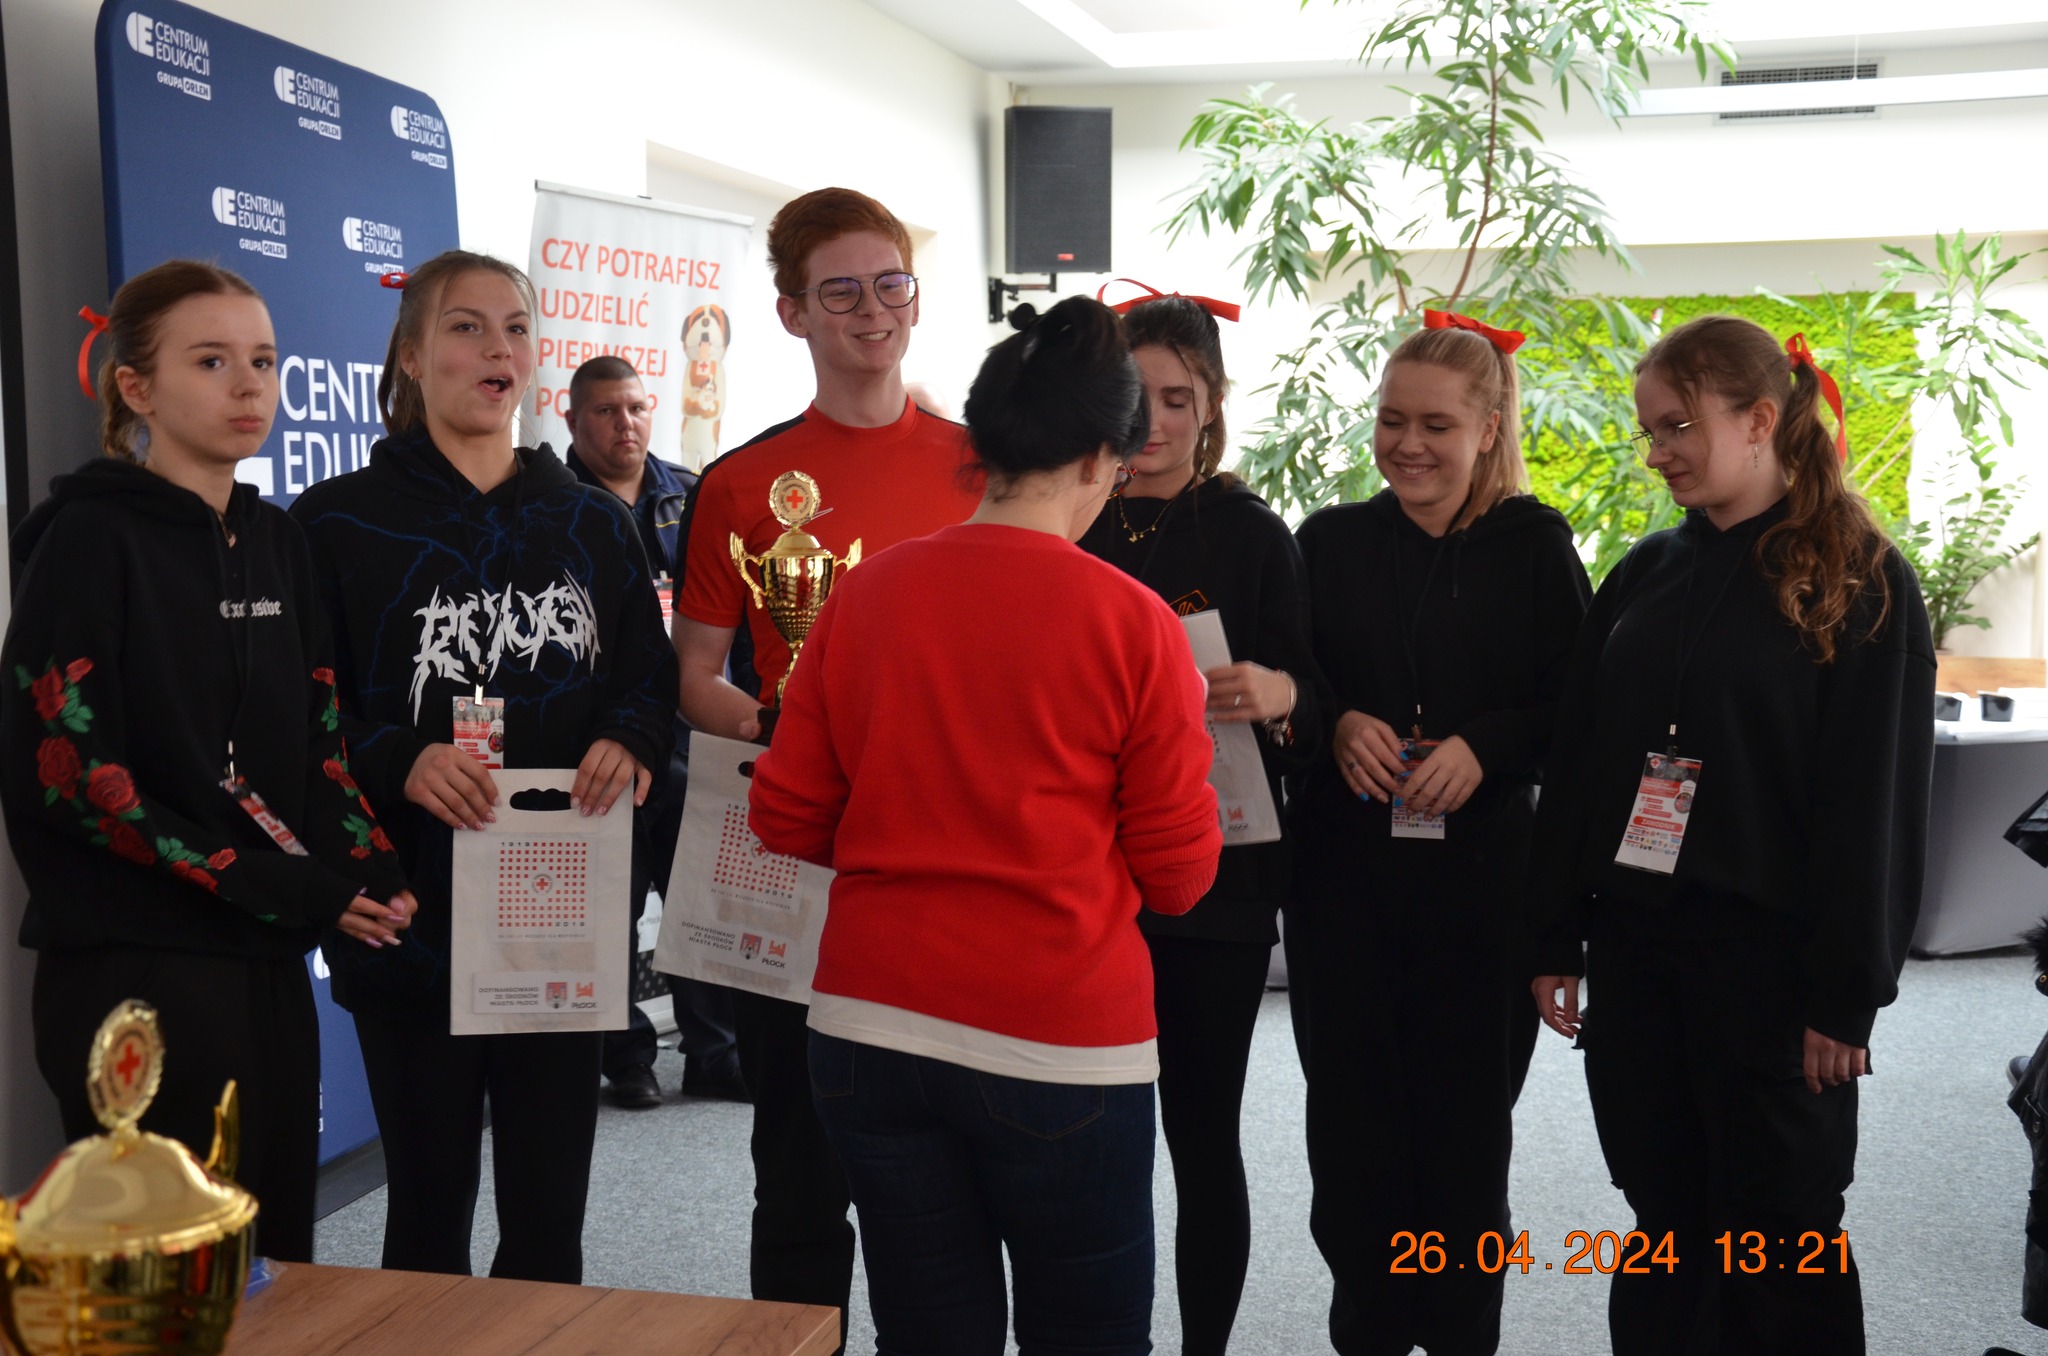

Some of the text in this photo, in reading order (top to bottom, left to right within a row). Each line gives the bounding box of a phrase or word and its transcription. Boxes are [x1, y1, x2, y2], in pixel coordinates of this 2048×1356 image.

[155, 21, 209, 58] CENTRUM
[156, 42, 210, 77] EDUKACJI
[156, 71, 210, 99] GRUPA ORLEN
[296, 72, 339, 101] CENTRUM
[297, 90, 340, 119] EDUKACJI
[298, 117, 341, 139] GRUPA ORLEN
[408, 110, 444, 135] CENTRUM
[410, 125, 446, 149] EDUKACJI
[411, 150, 447, 169] GRUPA ORLEN
[237, 191, 284, 218] CENTRUM
[238, 210, 286, 236] EDUKACJI
[362, 221, 402, 242] CENTRUM
[239, 238, 286, 258] GRUPA ORLEN
[363, 237, 403, 259] EDUKACJI
[364, 261, 383, 274] GRUPA
[541, 238, 720, 290] CZY POTRAFISZ
[540, 287, 649, 328] UDZIELIĆ
[279, 355, 385, 424] CENT
[761, 957, 786, 969] PŁOCK
